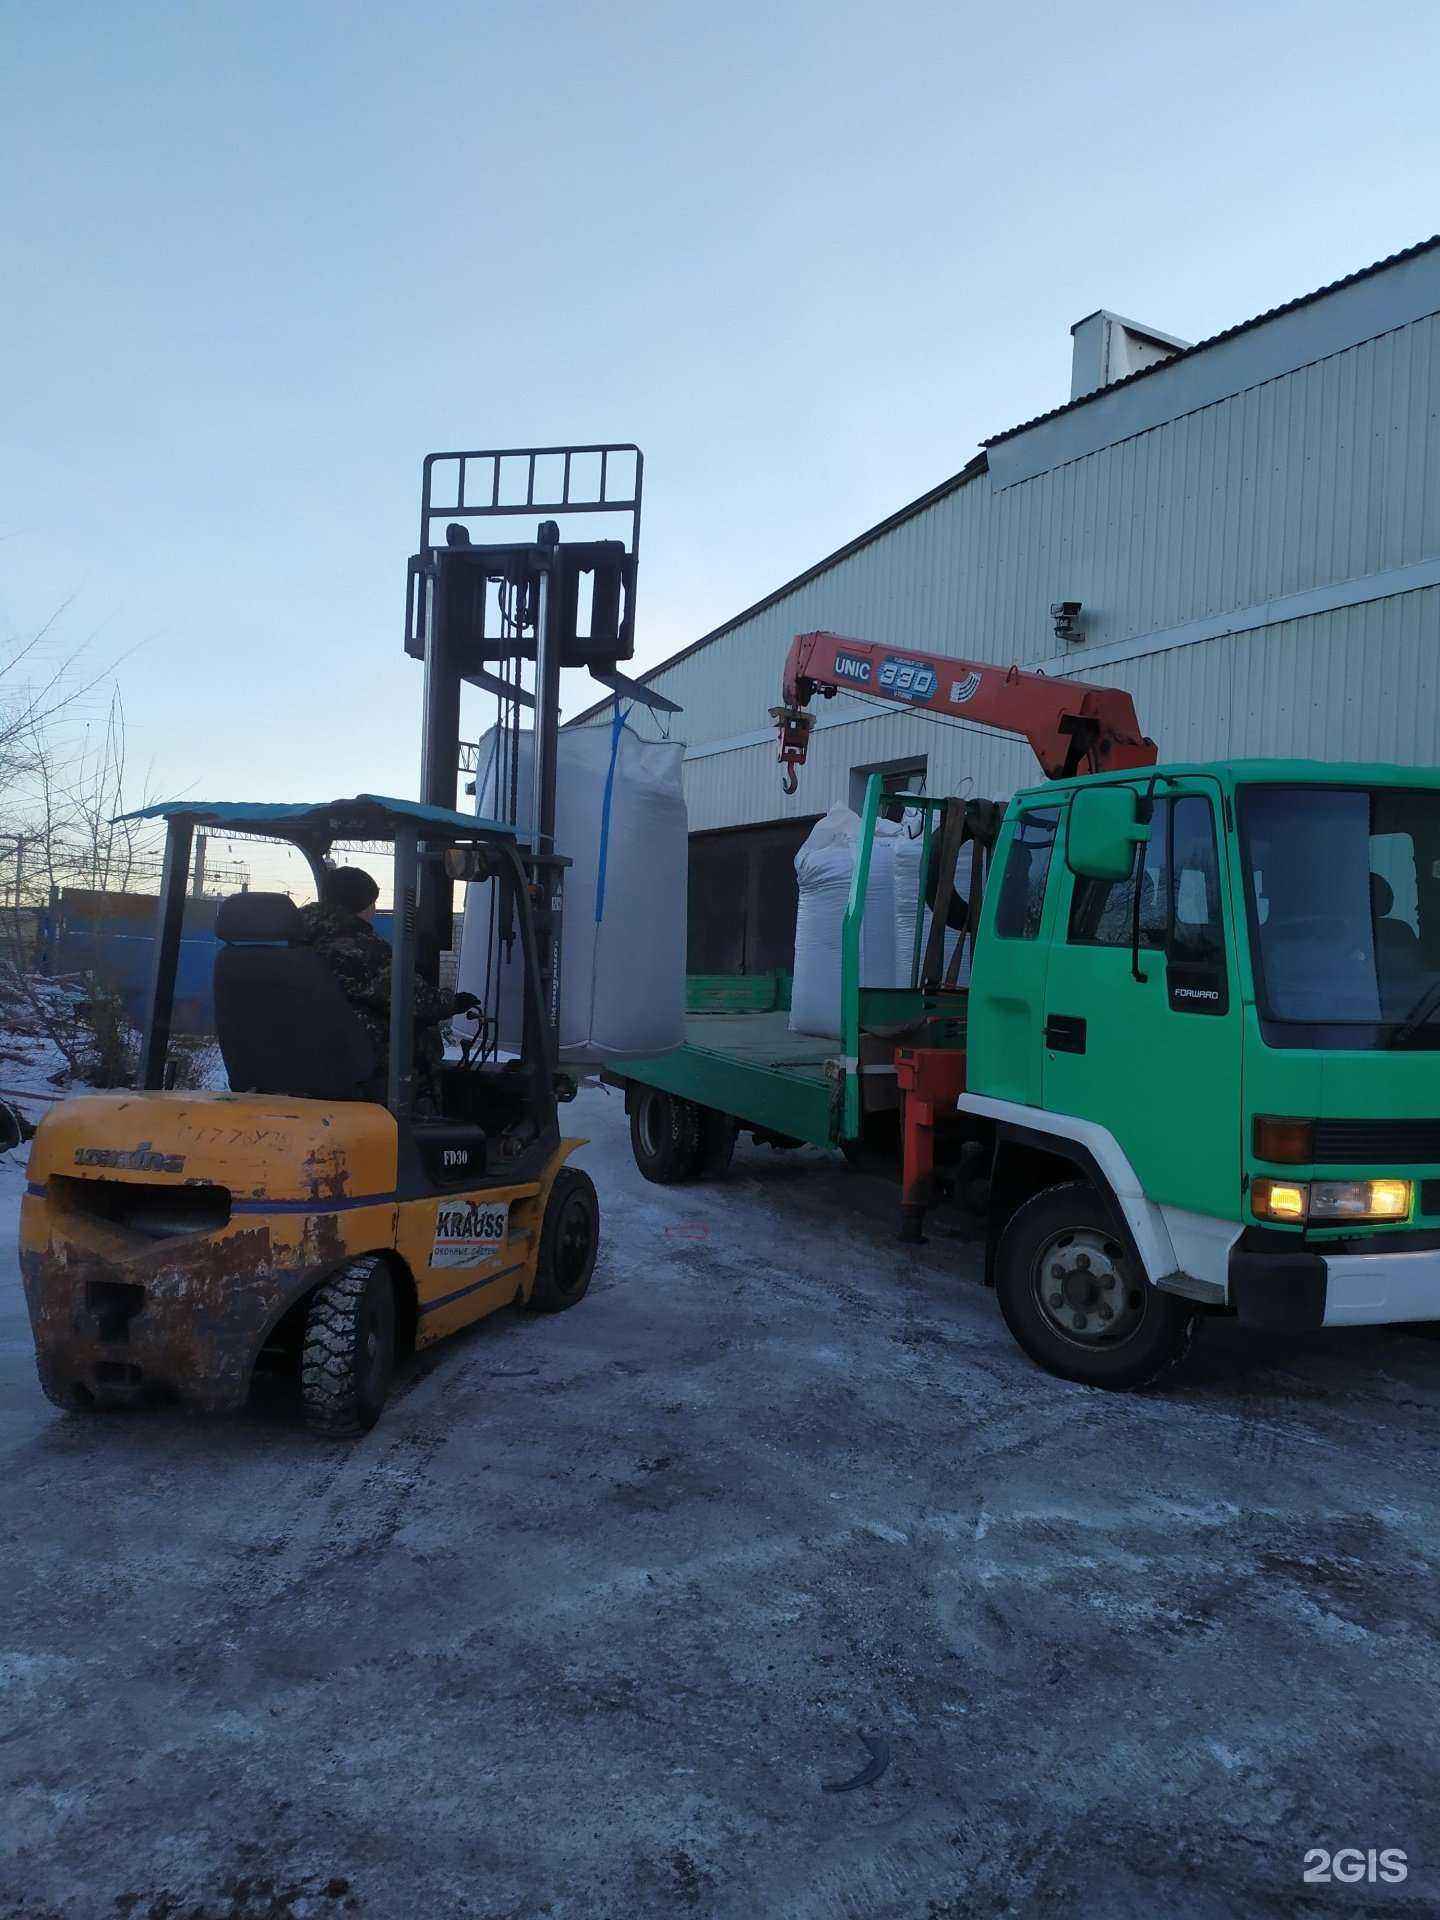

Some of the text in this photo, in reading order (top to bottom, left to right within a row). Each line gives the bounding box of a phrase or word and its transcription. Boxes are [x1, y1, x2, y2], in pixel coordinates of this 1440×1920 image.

[834, 656, 871, 680] UNIC
[1174, 988, 1219, 1000] FORWARD
[443, 1150, 468, 1165] FD30
[436, 1211, 505, 1238] KRAUSS
